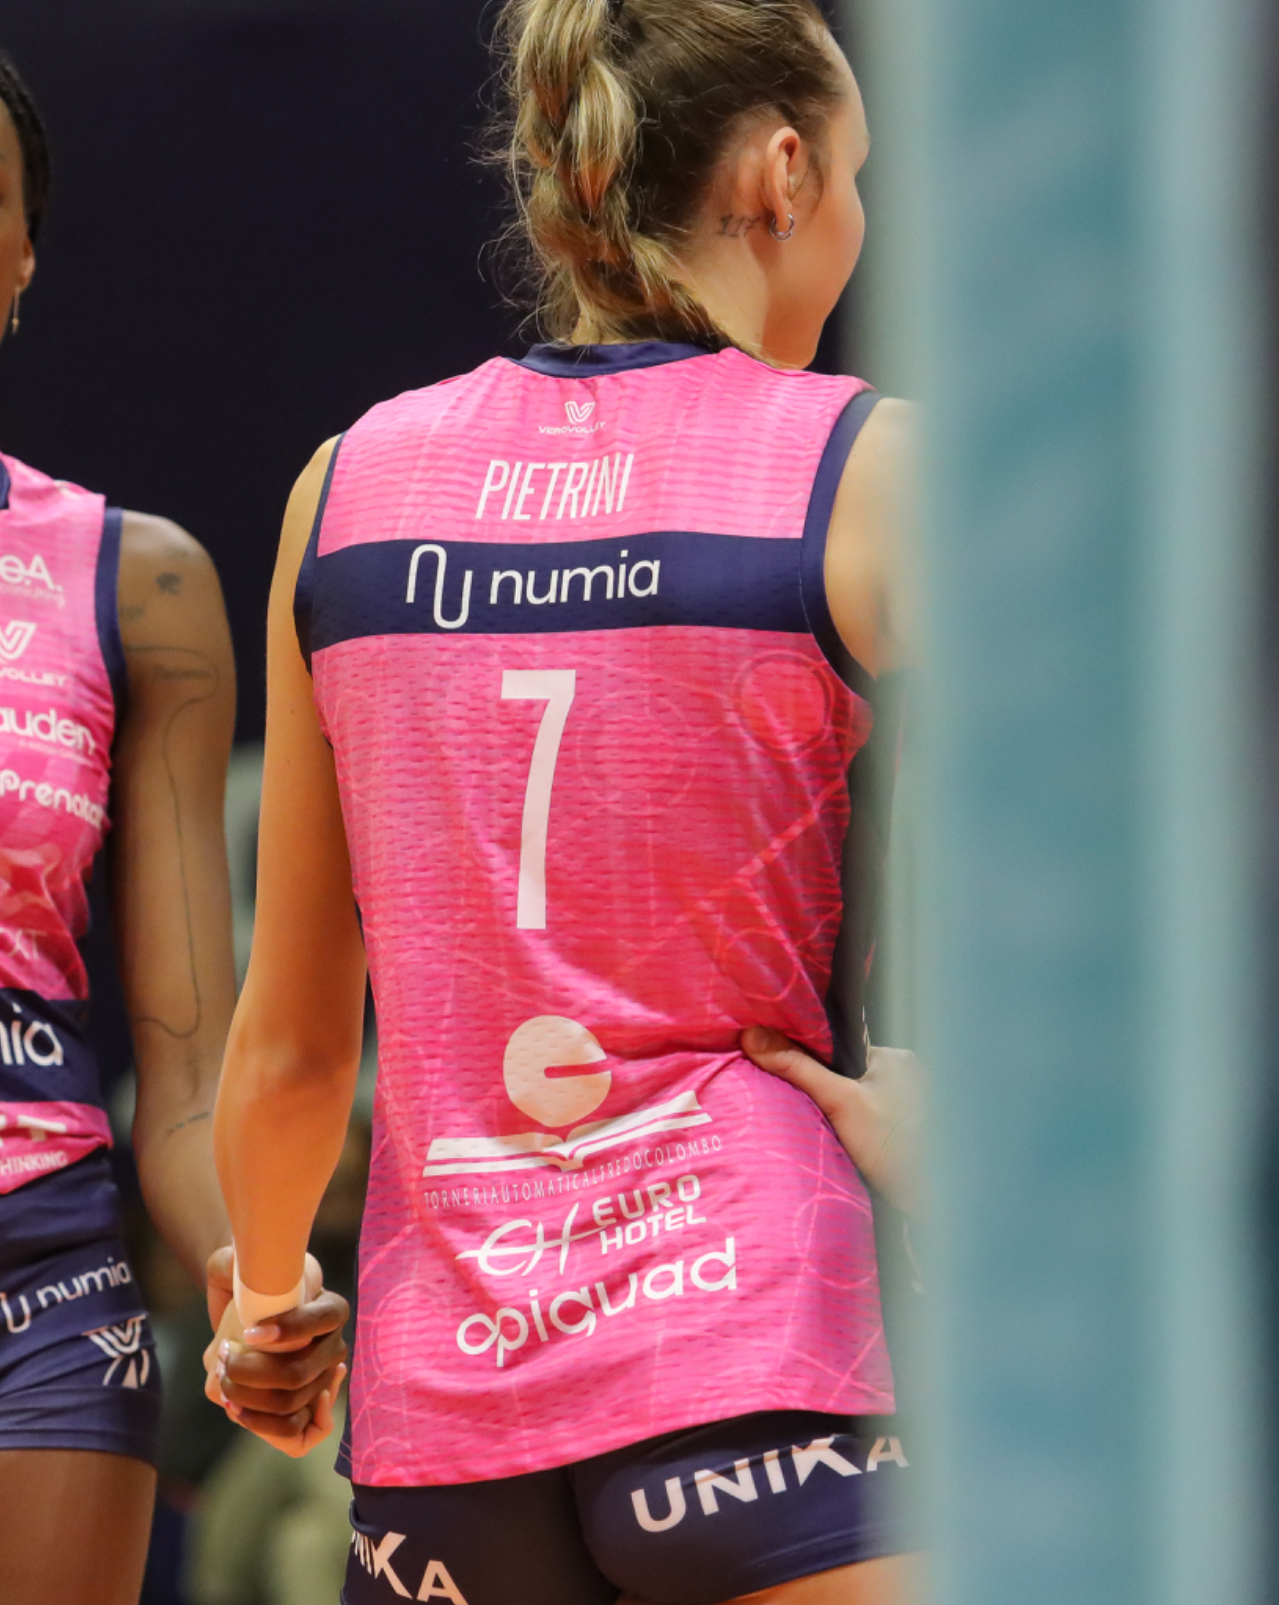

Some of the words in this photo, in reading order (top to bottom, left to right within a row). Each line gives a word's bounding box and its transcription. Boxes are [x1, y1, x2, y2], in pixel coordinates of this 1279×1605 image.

[475, 452, 634, 521] PIETRINI
[489, 550, 661, 606] numia
[501, 669, 576, 930] 7
[592, 1174, 702, 1227] EURO
[600, 1204, 707, 1255] HOTEL
[36, 1256, 132, 1308] numia
[630, 1433, 911, 1533] UNIKA
